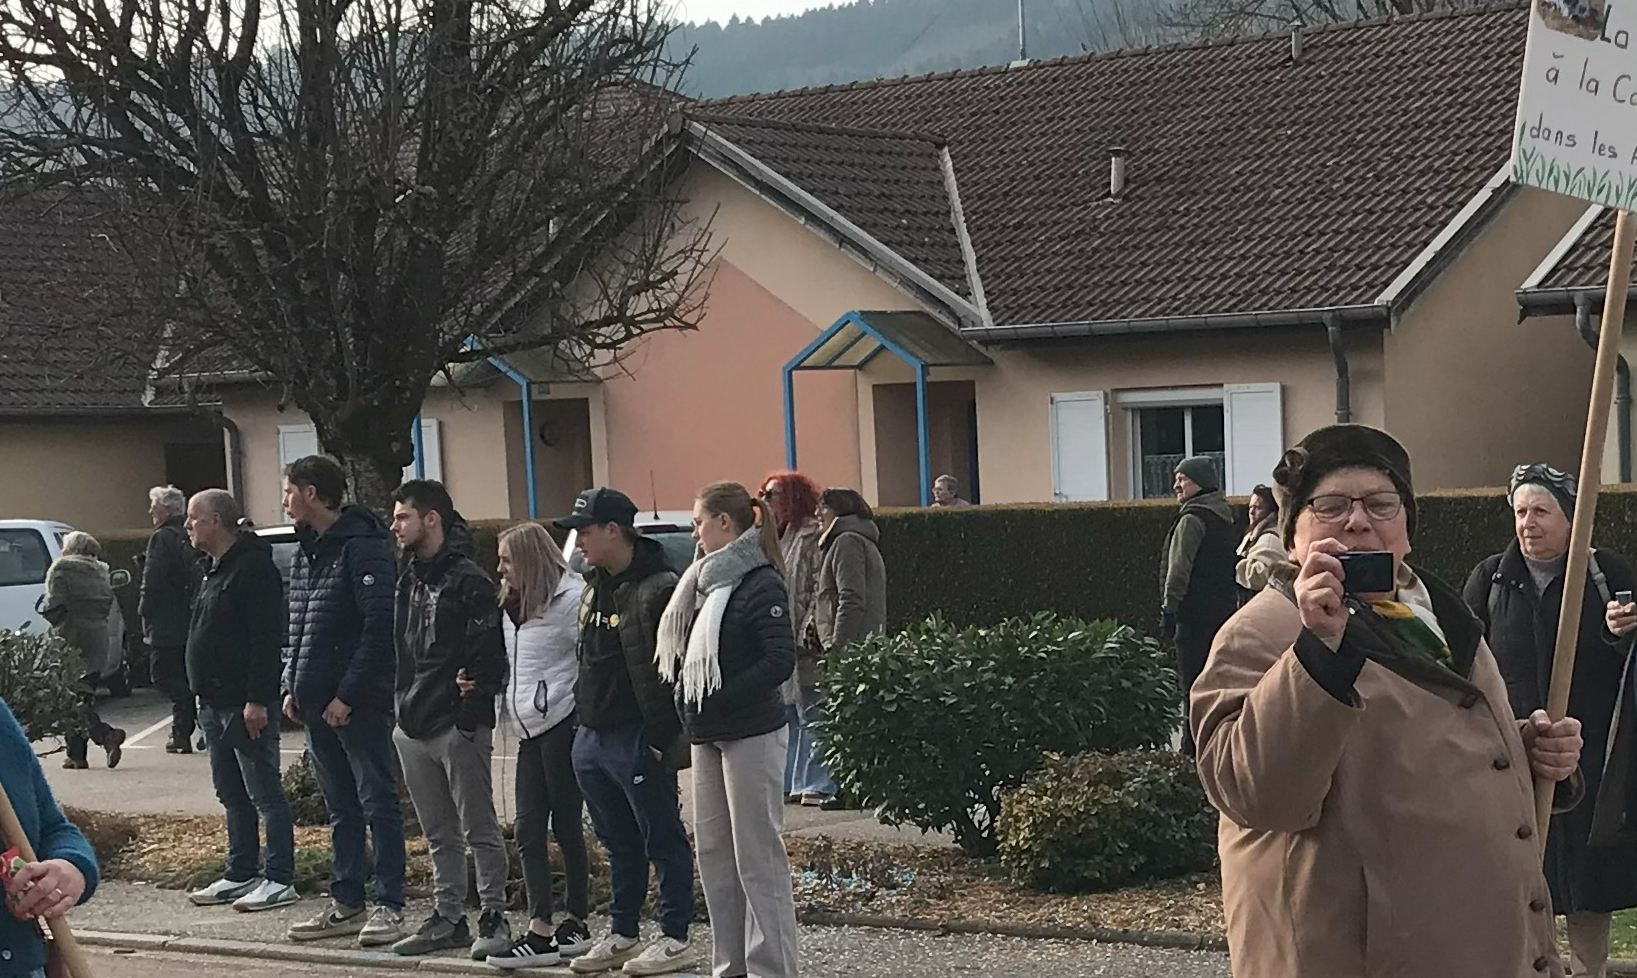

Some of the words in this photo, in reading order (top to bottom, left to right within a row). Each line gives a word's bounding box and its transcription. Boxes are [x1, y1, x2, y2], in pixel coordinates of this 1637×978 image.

[1600, 4, 1629, 50] La
[1579, 57, 1600, 96] la
[1530, 113, 1577, 148] dans
[1592, 130, 1618, 160] les
